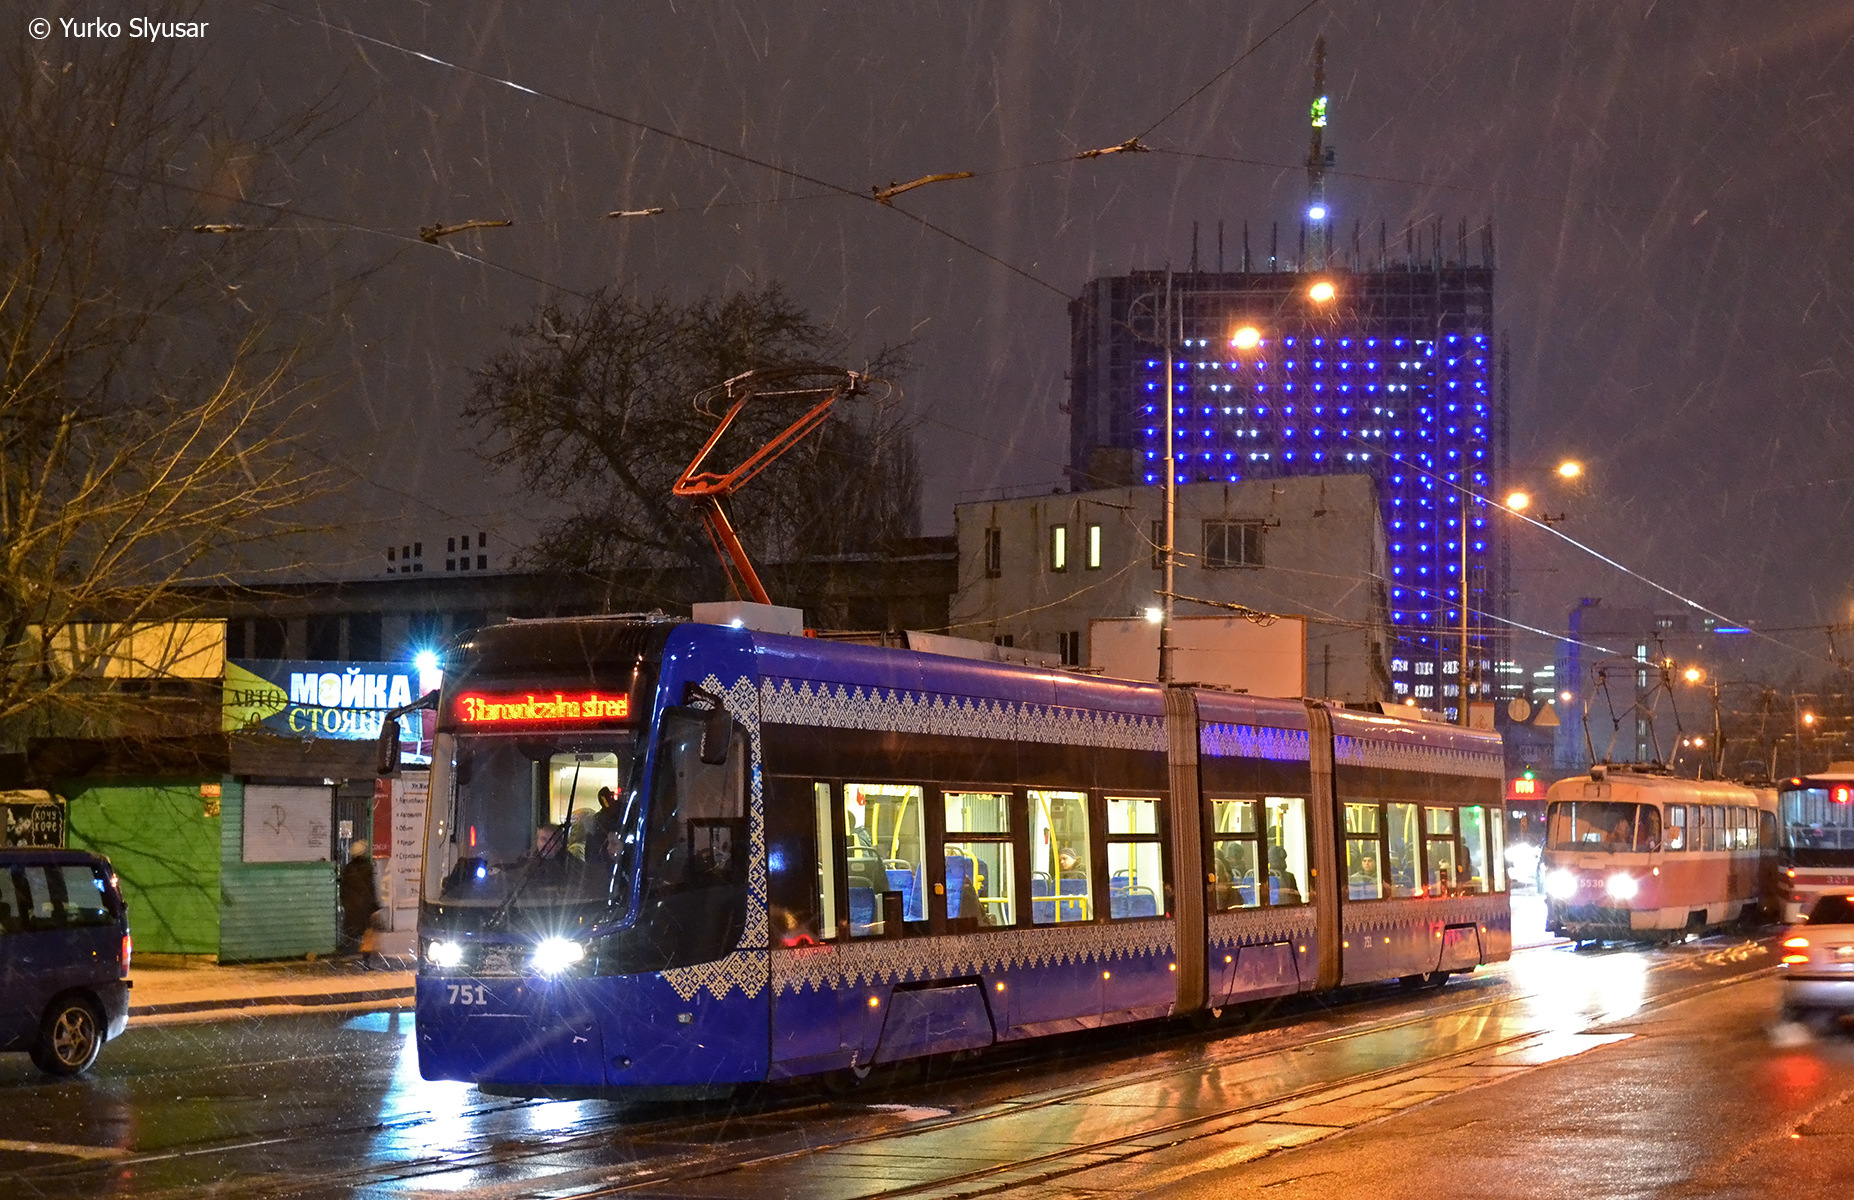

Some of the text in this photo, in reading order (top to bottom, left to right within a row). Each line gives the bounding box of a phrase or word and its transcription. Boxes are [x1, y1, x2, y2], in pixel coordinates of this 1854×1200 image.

[230, 689, 281, 708] АВТО
[290, 667, 412, 708] МОЙКА
[288, 708, 412, 734] СТОЯНА
[447, 984, 488, 1006] 751
